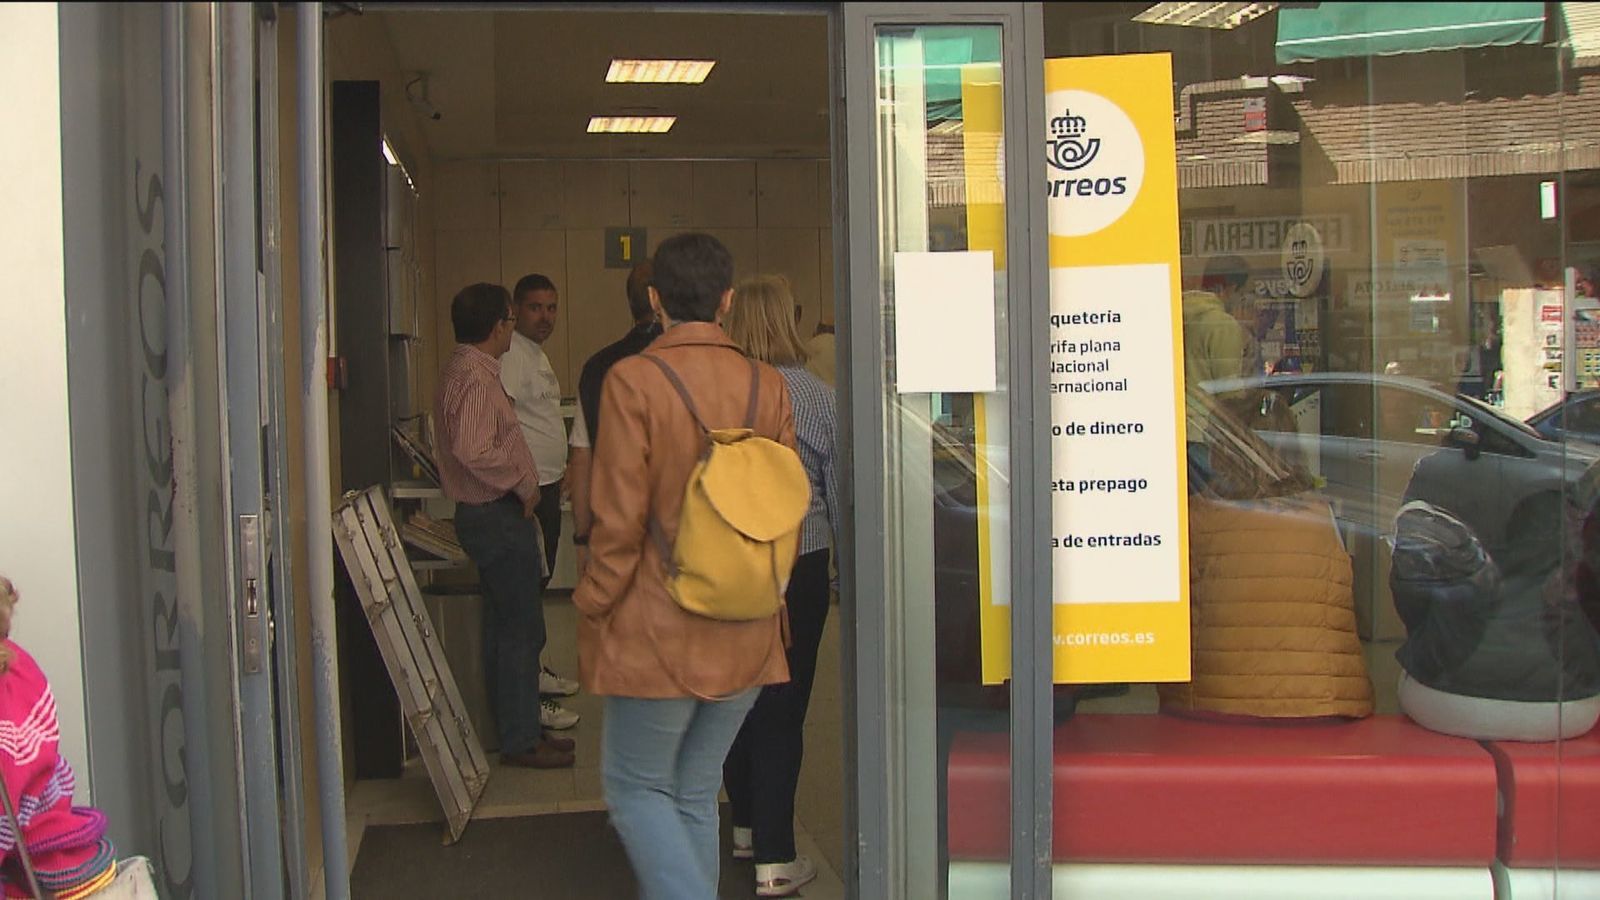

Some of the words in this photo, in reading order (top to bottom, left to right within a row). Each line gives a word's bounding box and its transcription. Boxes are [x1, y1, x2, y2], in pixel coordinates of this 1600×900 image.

[619, 235, 631, 260] 1
[1051, 339, 1076, 354] rifa
[1080, 339, 1121, 356] plana
[1066, 421, 1086, 436] de
[1090, 421, 1144, 435] dinero
[1079, 478, 1148, 494] prepago
[1063, 533, 1083, 548] de
[1087, 533, 1162, 548] entradas
